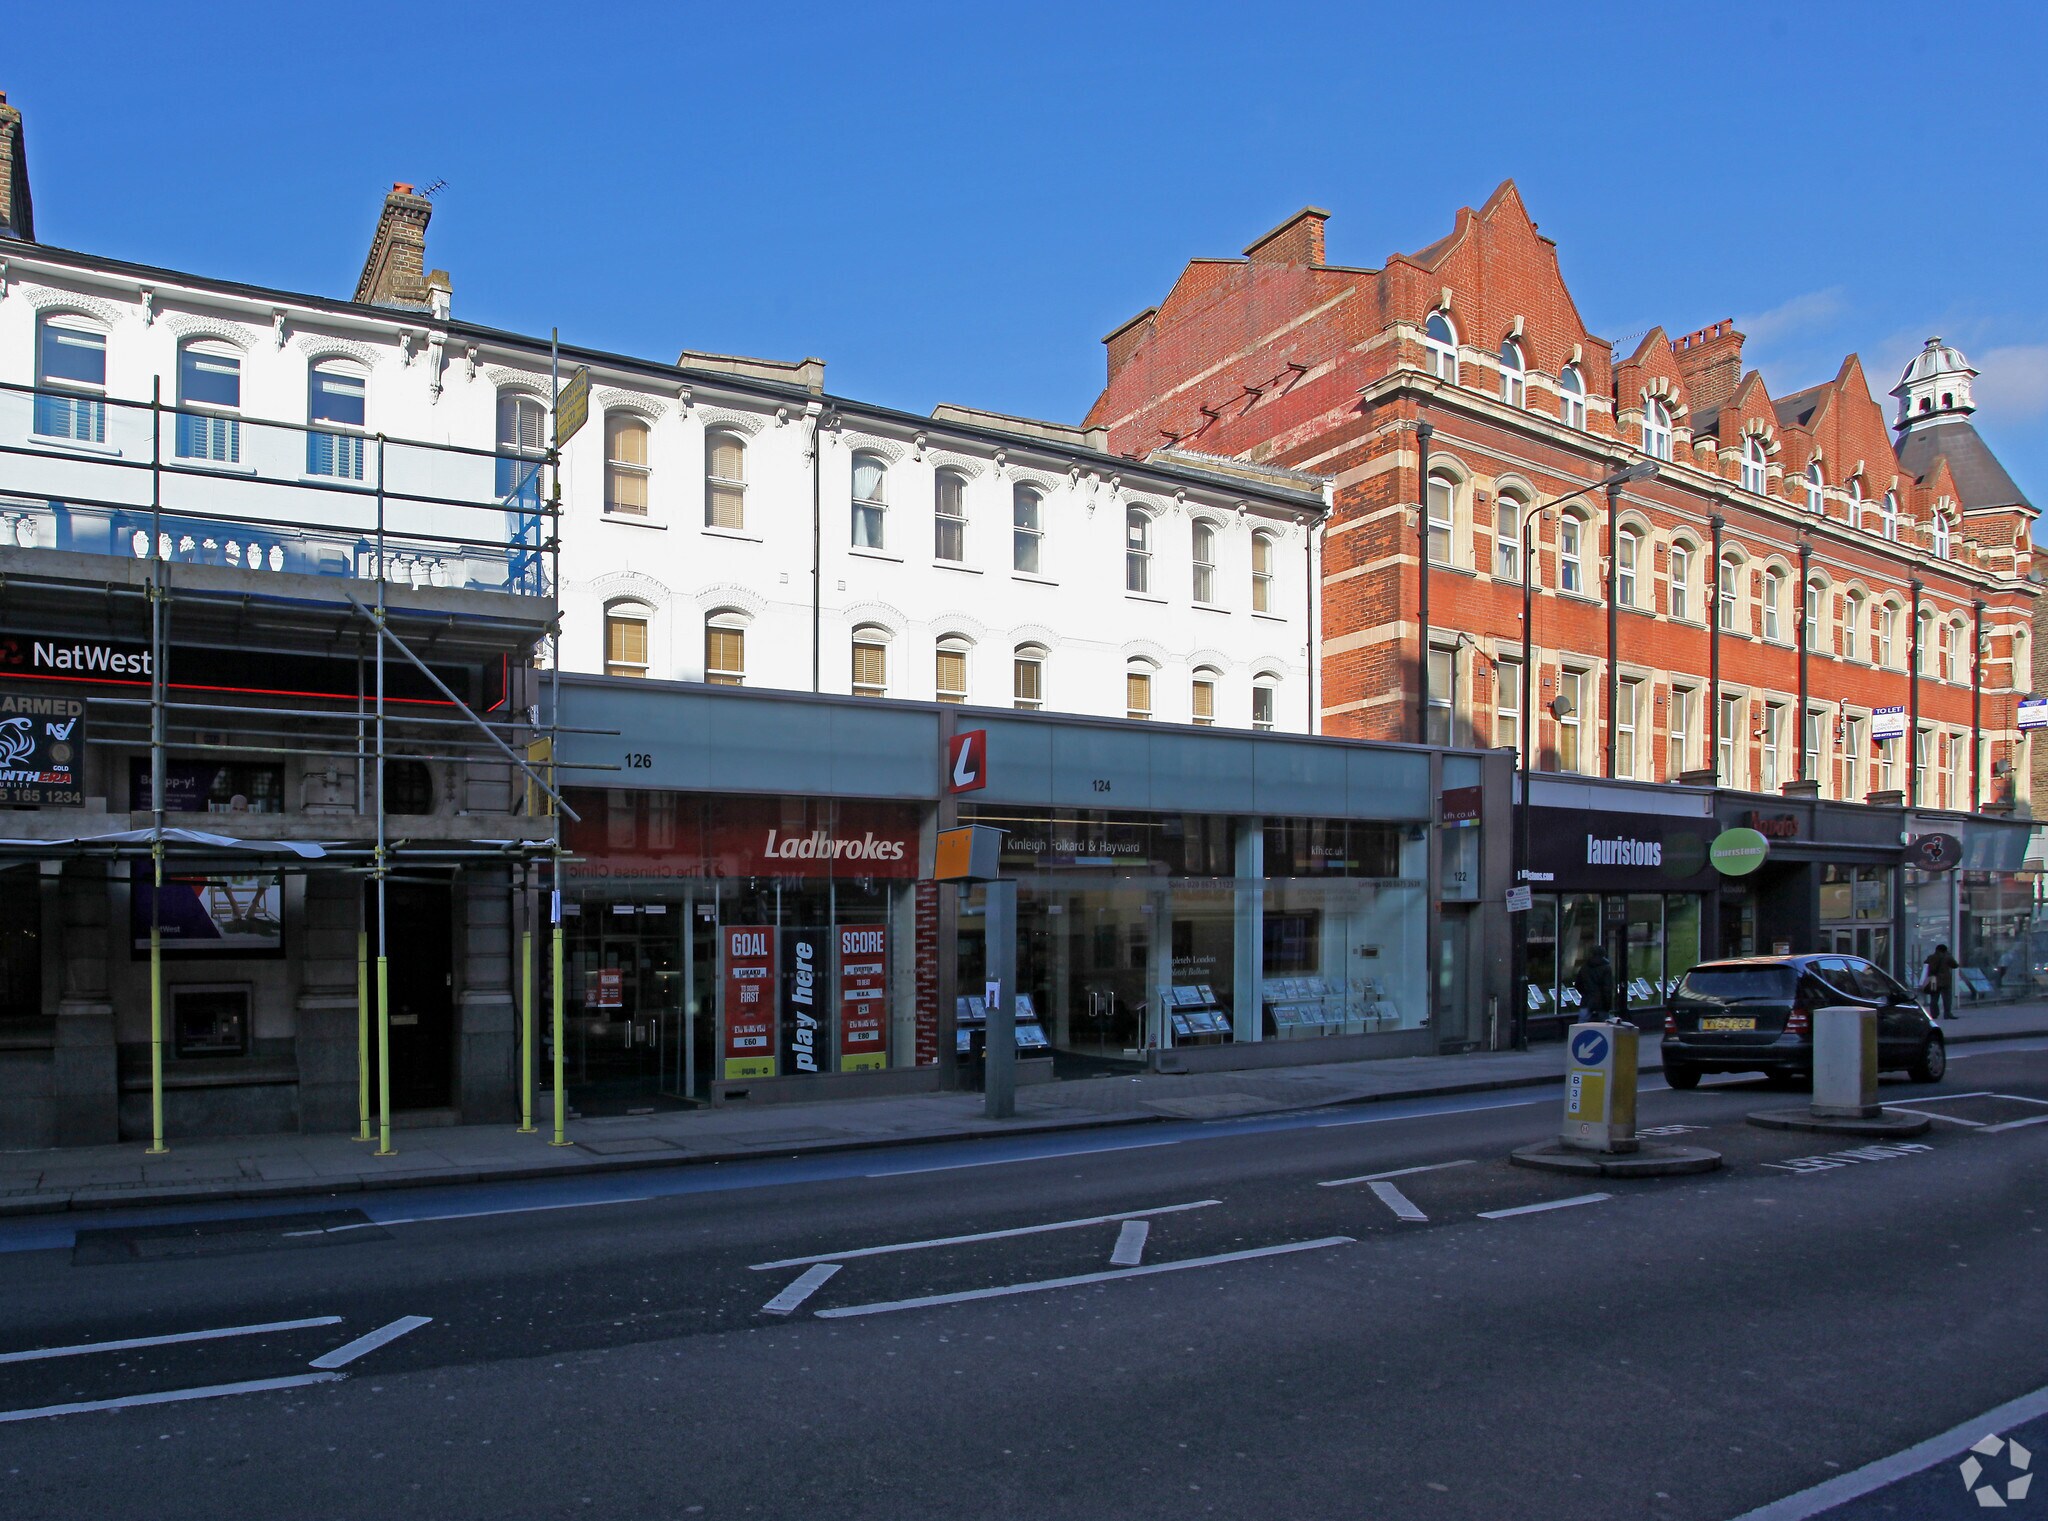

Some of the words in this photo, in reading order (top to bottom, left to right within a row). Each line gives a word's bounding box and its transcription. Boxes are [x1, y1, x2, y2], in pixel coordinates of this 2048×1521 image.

[34, 642, 153, 675] NatWest
[624, 753, 652, 769] 126
[1092, 779, 1112, 792] 124
[13, 789, 40, 802] 165
[46, 791, 81, 804] 1234
[764, 829, 905, 861] Ladbrokes
[1007, 838, 1047, 854] Kinleigh
[1088, 840, 1096, 852] &
[1100, 840, 1140, 855] Hayward
[1587, 833, 1661, 867] lauristons
[1454, 871, 1467, 882] 122
[732, 933, 768, 956] GOAL
[842, 931, 884, 954] SCORE
[1193, 955, 1217, 964] London
[791, 941, 814, 1006] here
[740, 992, 760, 1003] FIRST
[744, 1037, 757, 1046] £60
[791, 1010, 818, 1072] play
[858, 1032, 870, 1040] £80
